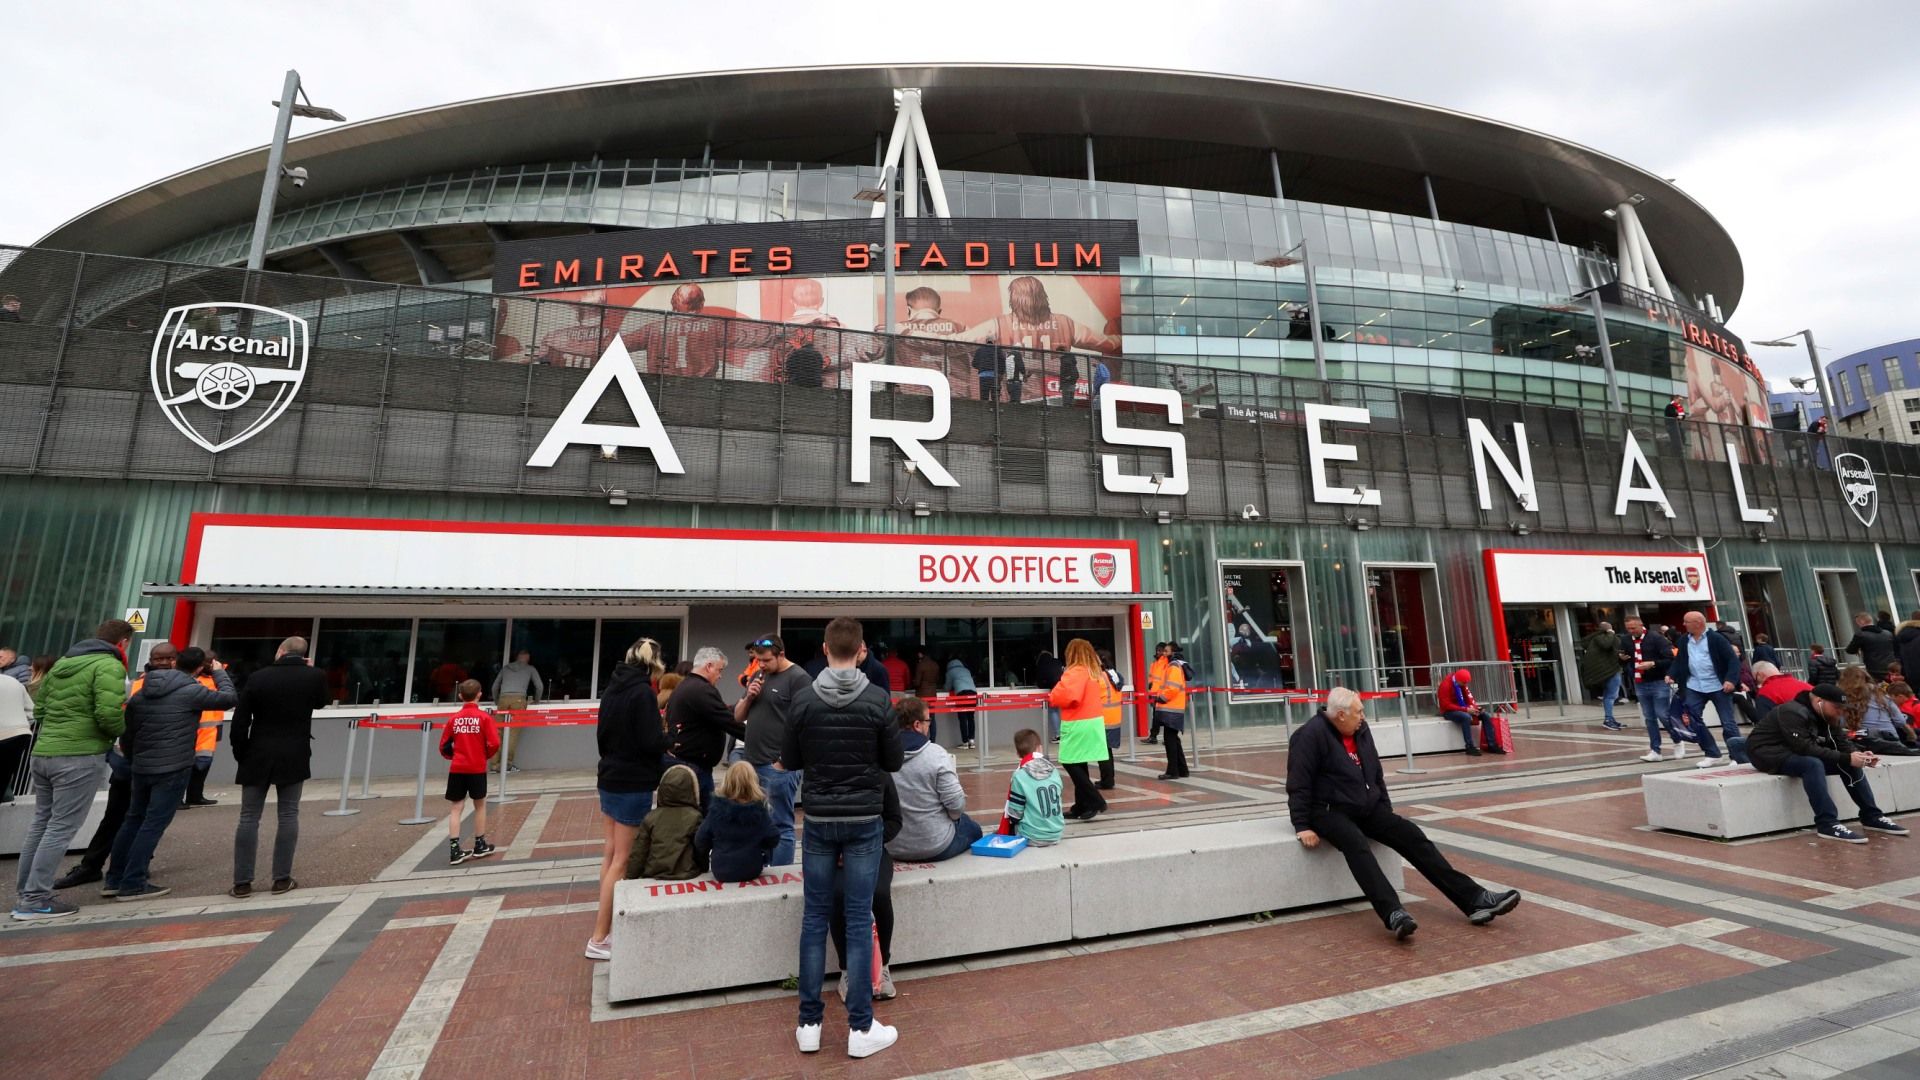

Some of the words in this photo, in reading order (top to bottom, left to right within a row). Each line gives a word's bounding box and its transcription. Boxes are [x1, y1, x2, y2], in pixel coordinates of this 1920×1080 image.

[518, 246, 793, 288] EMIRATES
[845, 242, 1101, 269] STADIUM
[176, 328, 288, 357] Arsenal
[1227, 406, 1244, 417] The
[1245, 408, 1278, 420] Arenal
[526, 332, 1775, 523] ARSENAL
[1842, 466, 1870, 479] Arsenal
[919, 554, 981, 583] BOX
[988, 555, 1080, 584] OFFICE
[1604, 566, 1632, 584] The
[1634, 566, 1685, 584] Arsenal
[452, 725, 480, 735] EAGLES
[453, 717, 480, 726] SOTON
[1036, 784, 1061, 818] 09
[644, 879, 725, 897] TONY
[738, 871, 804, 888] ADA
